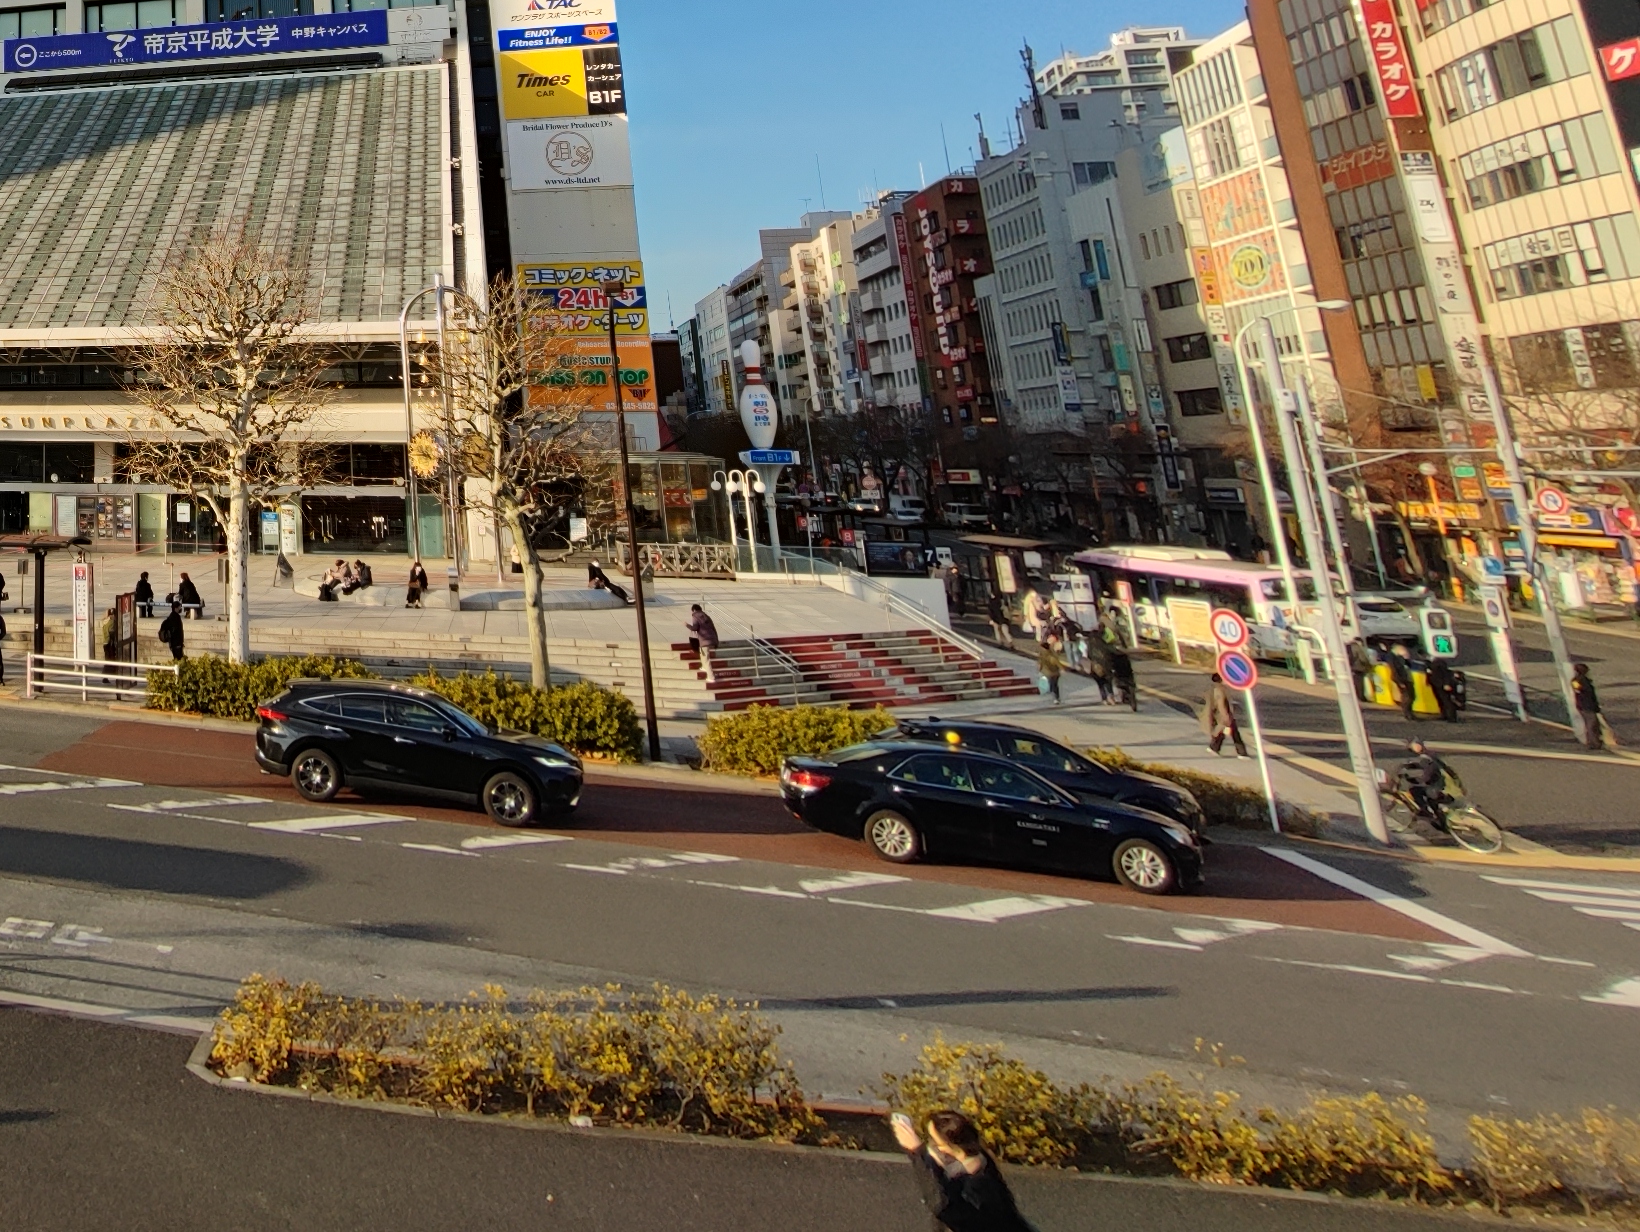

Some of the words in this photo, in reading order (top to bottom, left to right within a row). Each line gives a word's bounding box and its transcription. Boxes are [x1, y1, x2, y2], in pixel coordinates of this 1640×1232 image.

[144, 24, 280, 55] 帝京平成大学
[291, 23, 369, 40] 中野キャンパス
[525, 29, 556, 38] ENJOY
[510, 38, 543, 47] Fitness
[39, 49, 82, 58] ここから500m
[1371, 21, 1410, 101] カラオケ
[586, 63, 621, 71] レンタカー
[517, 73, 572, 89] Times
[587, 74, 622, 82] カーシェア
[536, 90, 555, 98] CAR
[589, 90, 622, 104] B1F
[522, 122, 545, 131] Bridal
[545, 122, 569, 130] Flower
[571, 121, 599, 129] Produce
[544, 176, 601, 186] www.ds-ltd.net
[525, 266, 640, 285] コミック・ネット
[918, 208, 950, 356] JOYSOUND
[558, 288, 610, 311] 24h
[589, 355, 622, 366] STUD
[0, 416, 161, 429] SUNPLAZA
[844, 532, 852, 542] 8
[1219, 620, 1238, 638] 40
